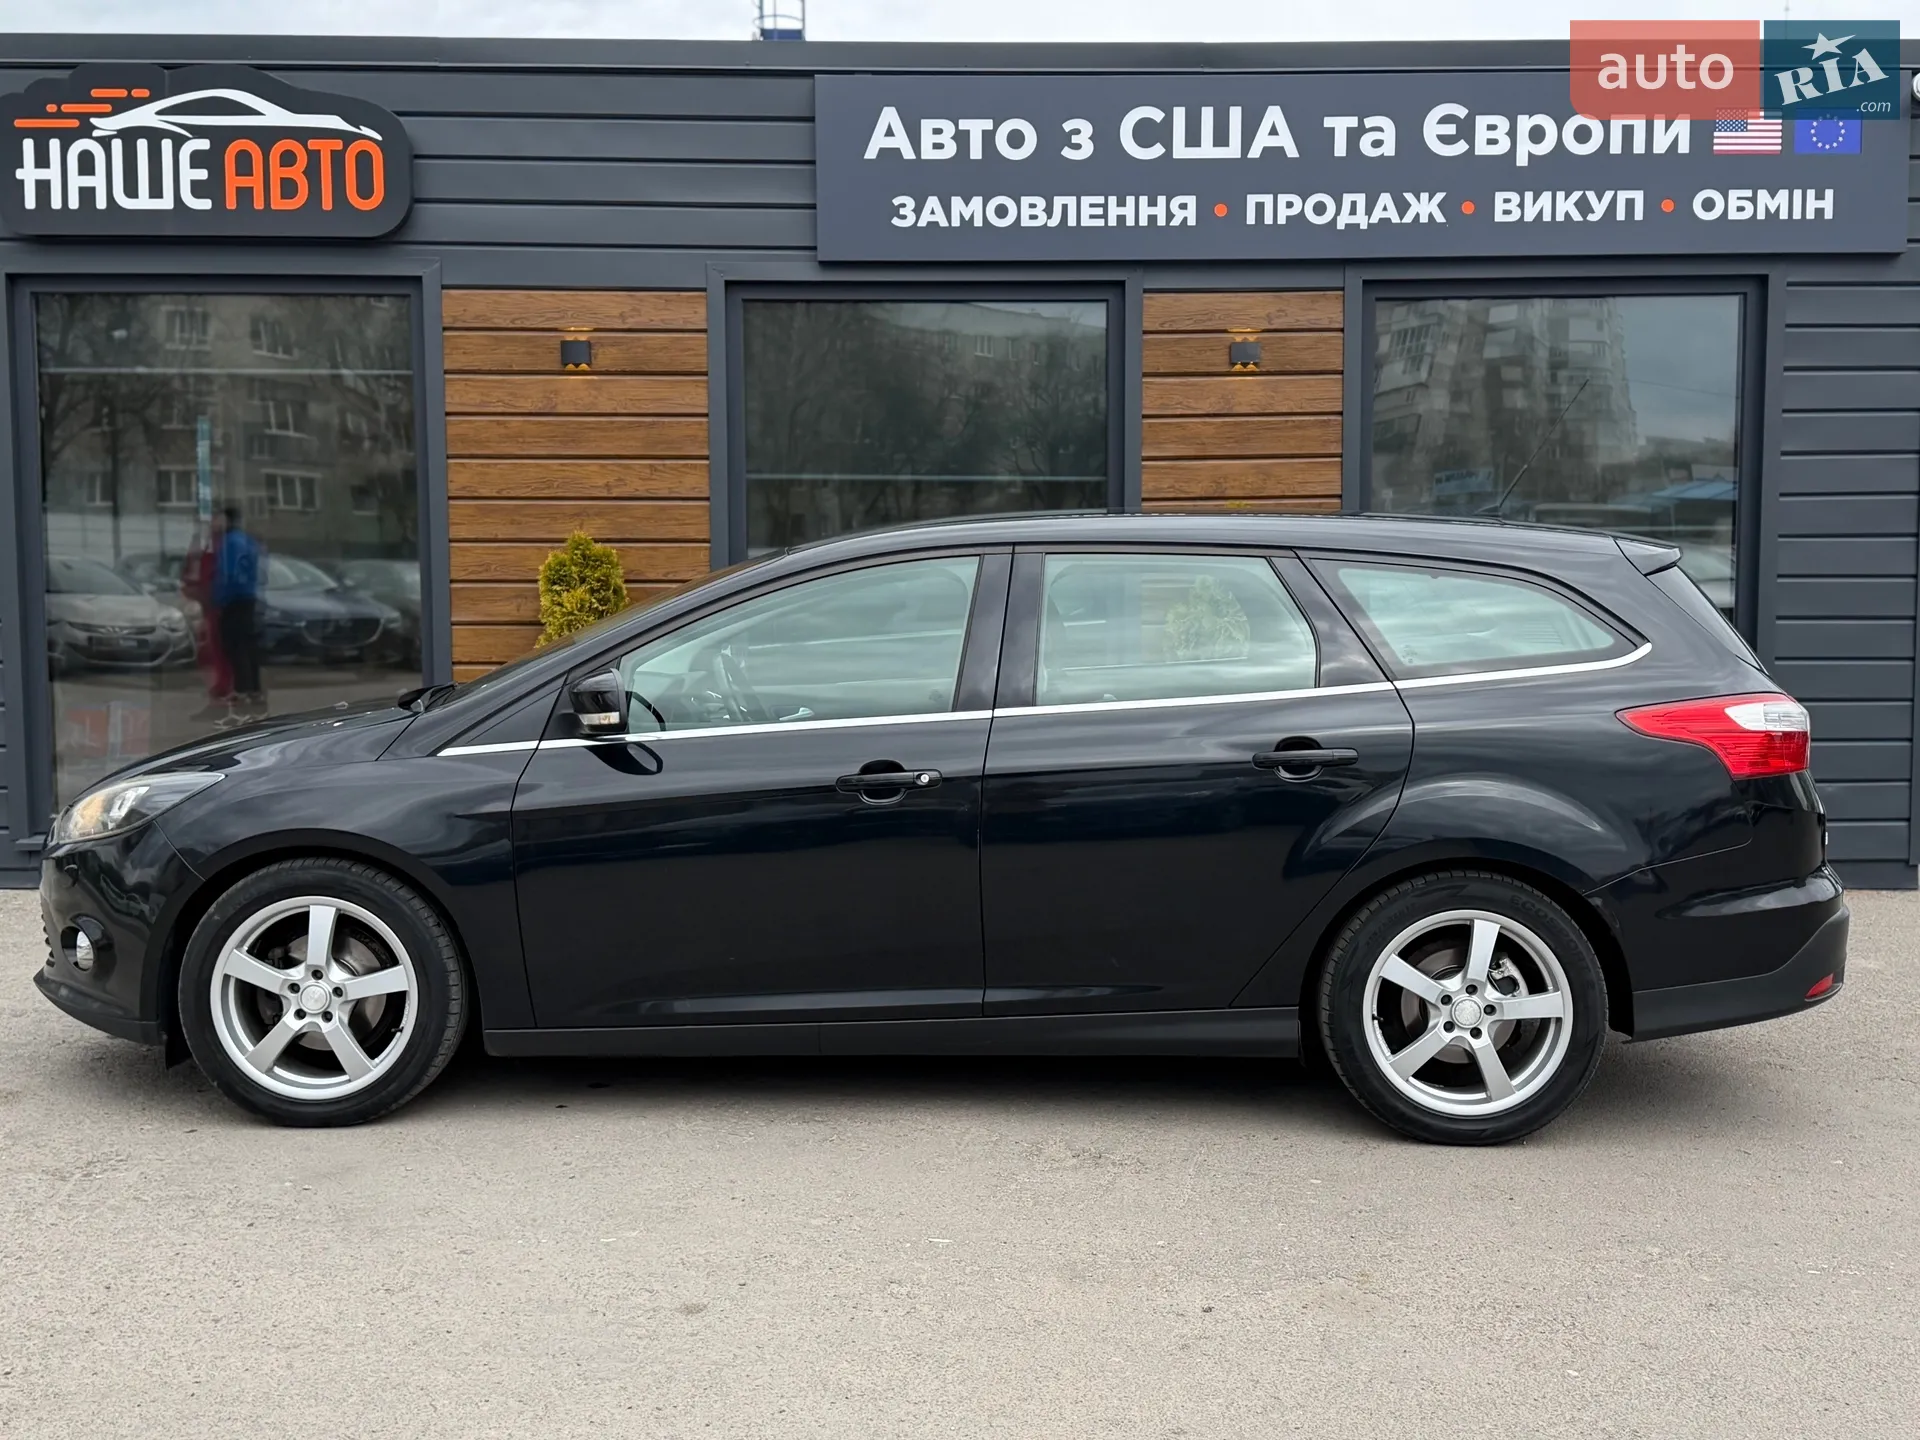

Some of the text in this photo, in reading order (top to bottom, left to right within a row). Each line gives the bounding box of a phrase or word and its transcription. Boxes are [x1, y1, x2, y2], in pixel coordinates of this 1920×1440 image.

[863, 102, 1691, 167] Авто з США та Європи
[15, 138, 385, 211] НАШЕ АВТО
[890, 188, 1834, 230] ЗАМОВЛЕННЯ ПРОДАЖ ВИКУП ОБМІН
